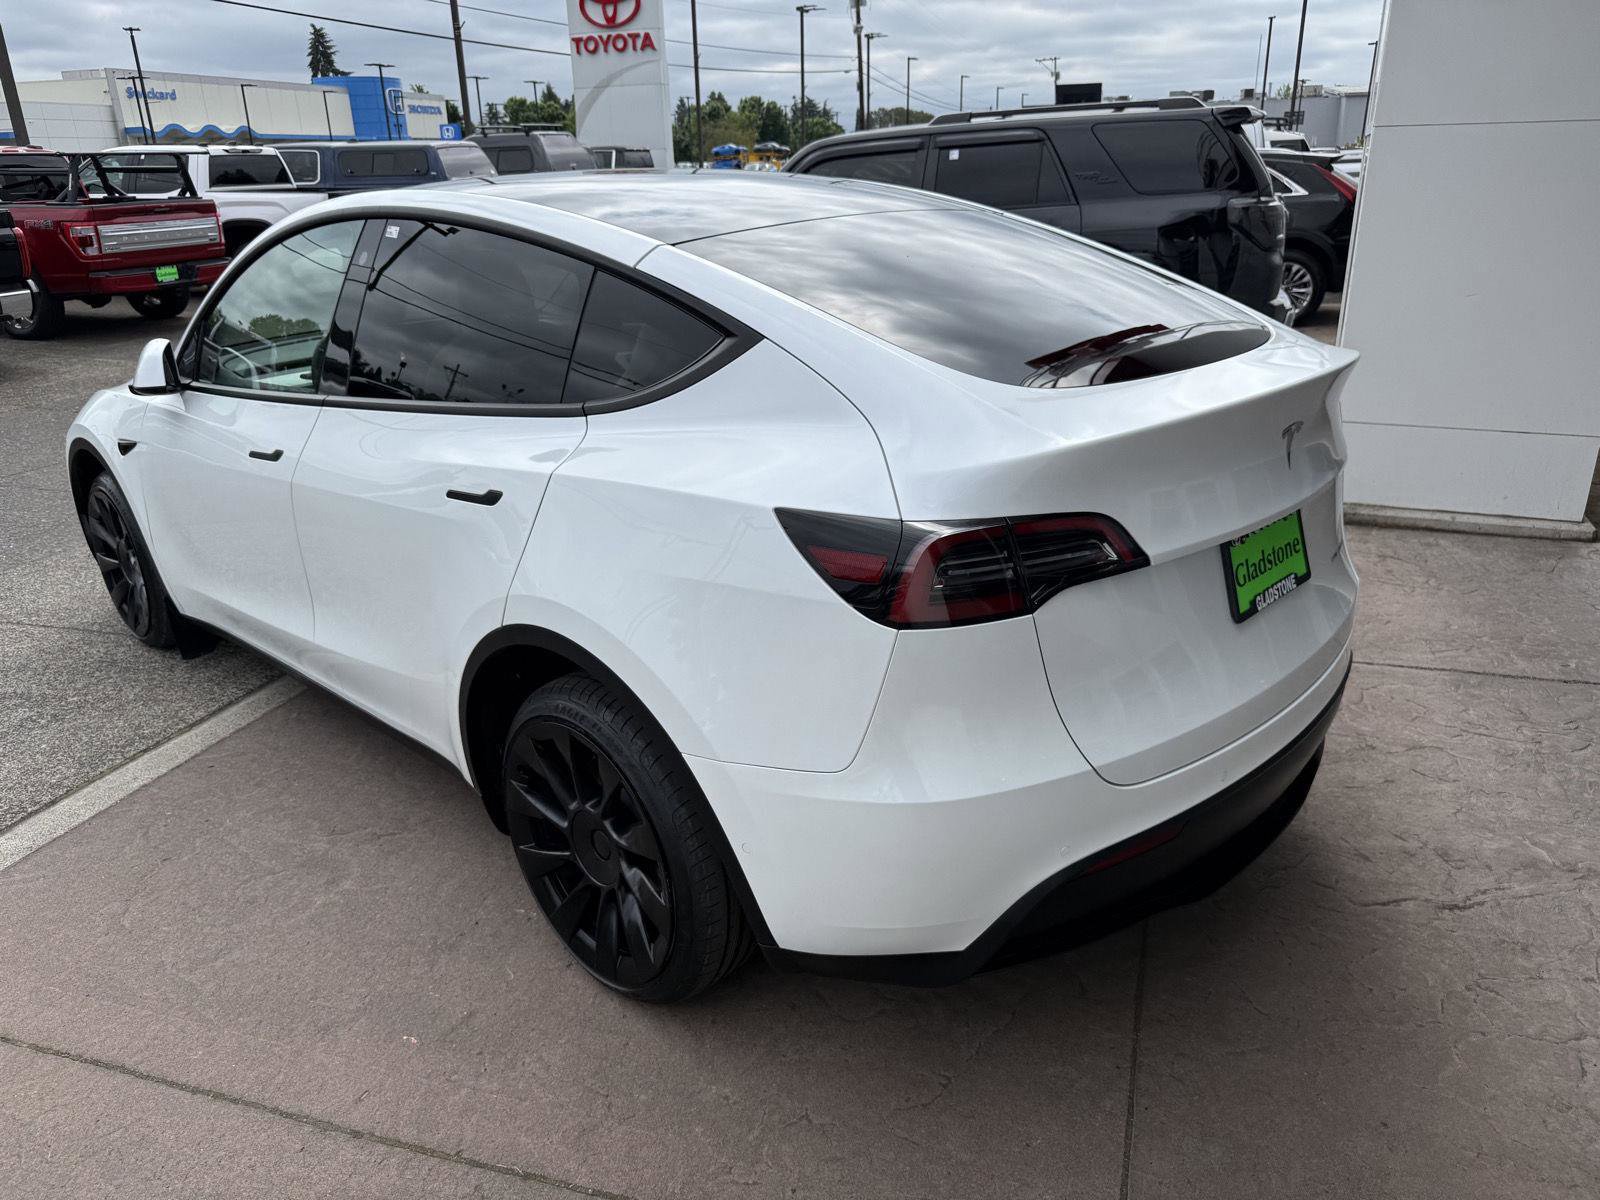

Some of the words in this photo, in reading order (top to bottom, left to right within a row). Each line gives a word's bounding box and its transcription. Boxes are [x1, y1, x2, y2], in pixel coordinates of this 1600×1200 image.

[571, 32, 657, 55] TOYOTA
[126, 86, 177, 101] Swckard
[1235, 537, 1301, 588] Gladstone
[1256, 573, 1297, 611] GLADSTONE
